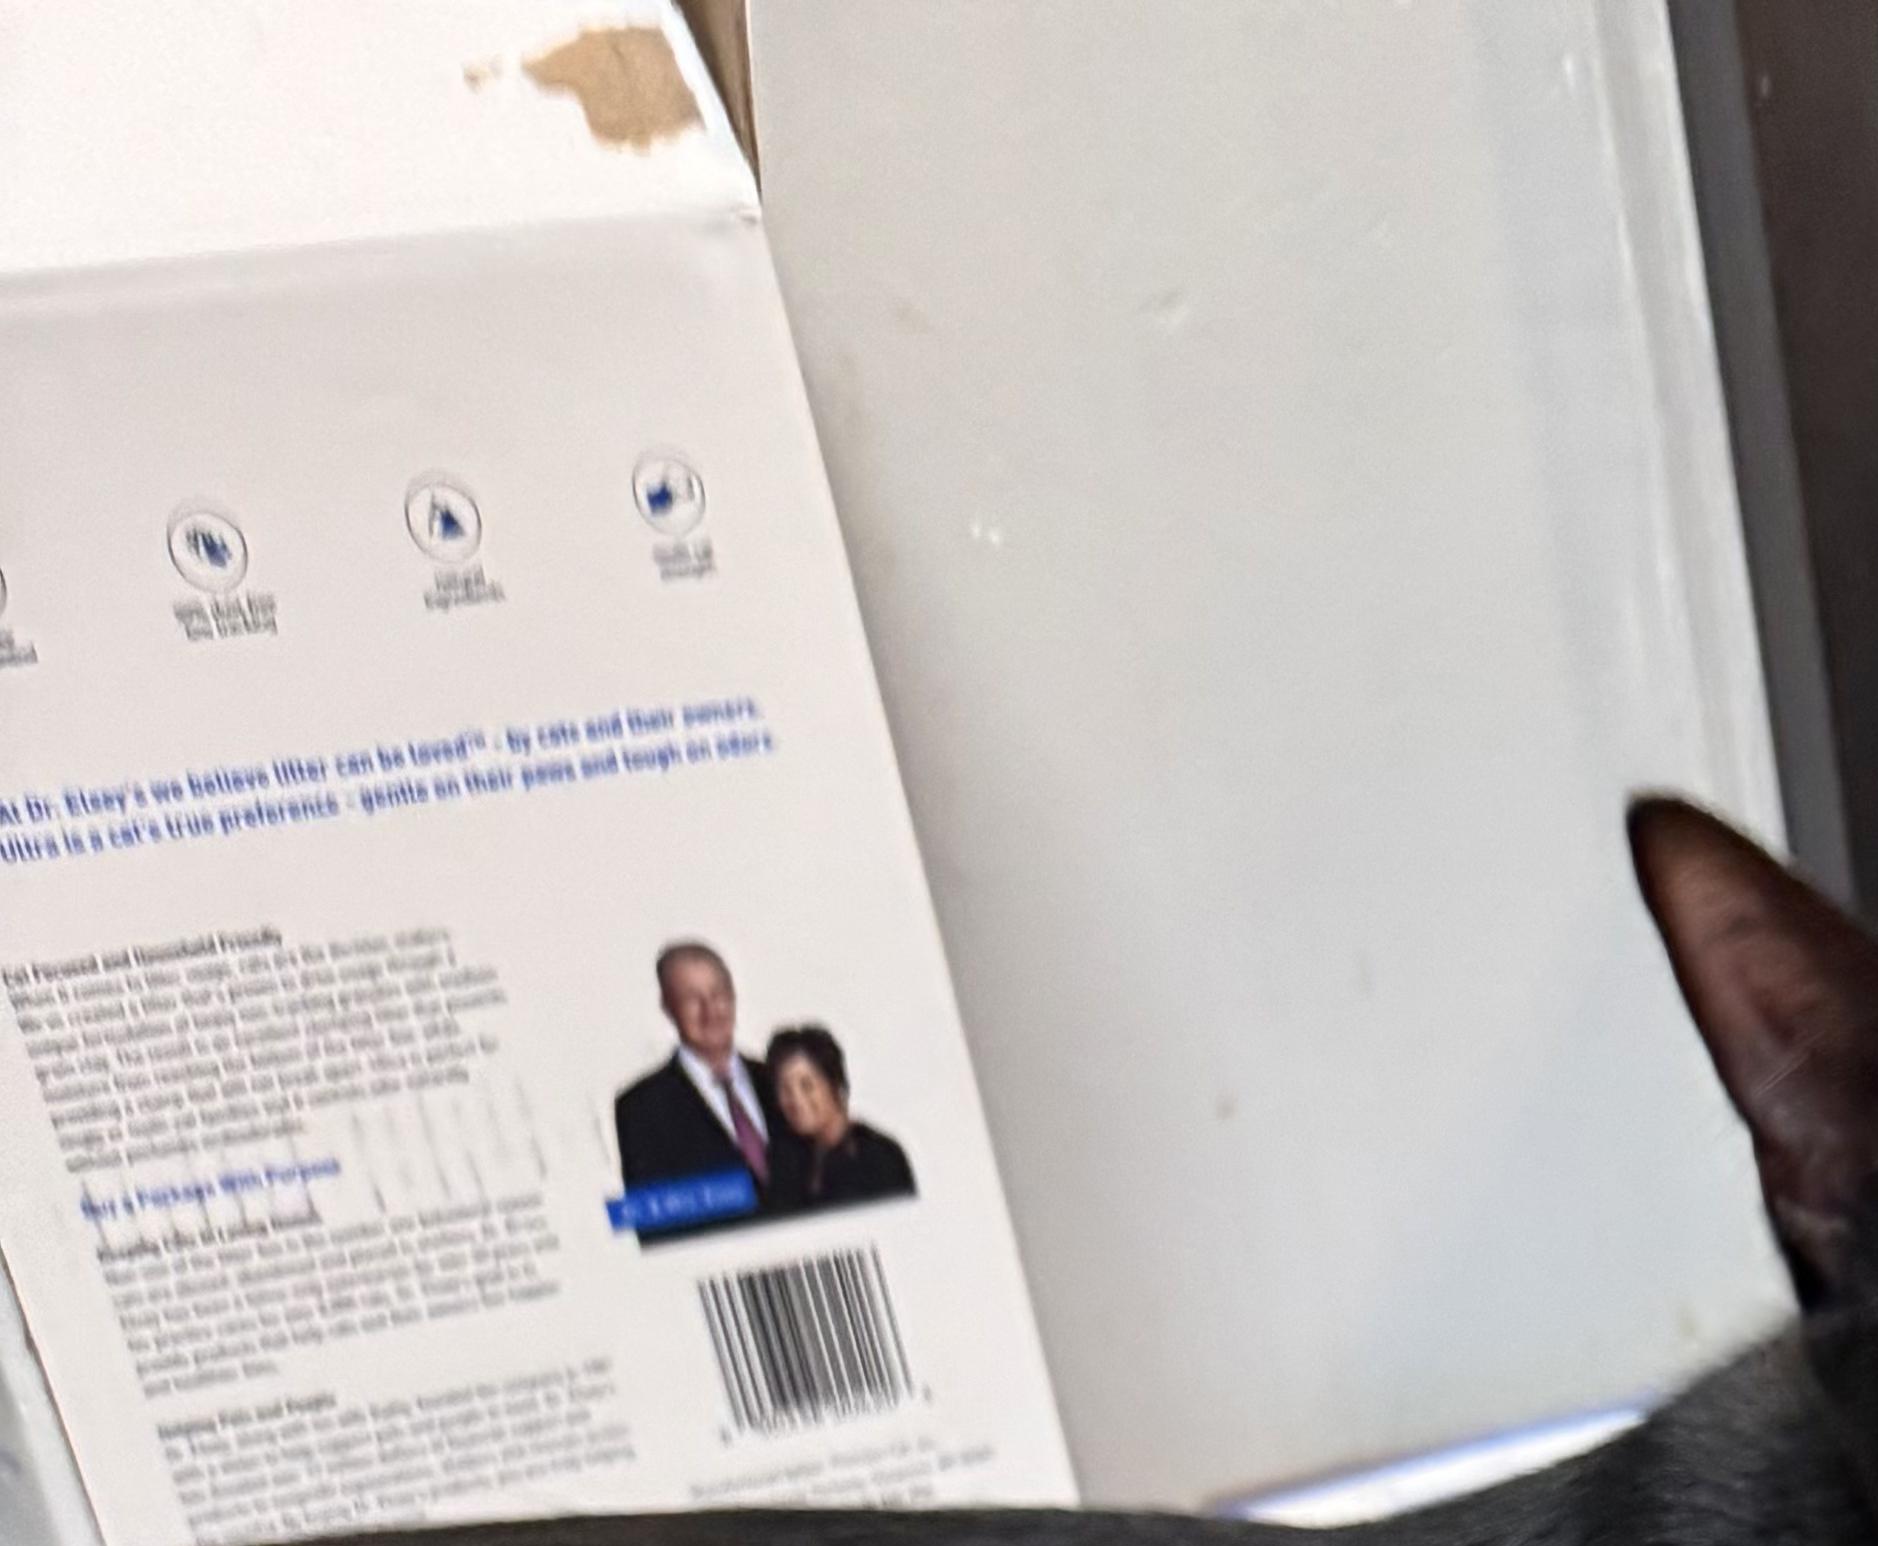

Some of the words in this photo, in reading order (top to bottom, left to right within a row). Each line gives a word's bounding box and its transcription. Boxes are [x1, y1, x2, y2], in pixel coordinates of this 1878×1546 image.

[24, 792, 61, 822] Dr.
[63, 781, 147, 815] Elsey's
[150, 776, 183, 801] we
[186, 766, 270, 799] believe
[272, 755, 327, 788] litter
[334, 750, 375, 778] can
[377, 742, 403, 772] be
[506, 725, 532, 756] by
[536, 720, 581, 749] cats
[585, 708, 623, 741] and
[627, 704, 676, 735] their
[165, 810, 215, 840] true
[217, 796, 340, 837] preference
[360, 783, 430, 816] gentle
[433, 776, 461, 799] on
[464, 766, 514, 795] their
[580, 748, 619, 777] and
[622, 740, 683, 772] tough
[686, 737, 712, 762] on
